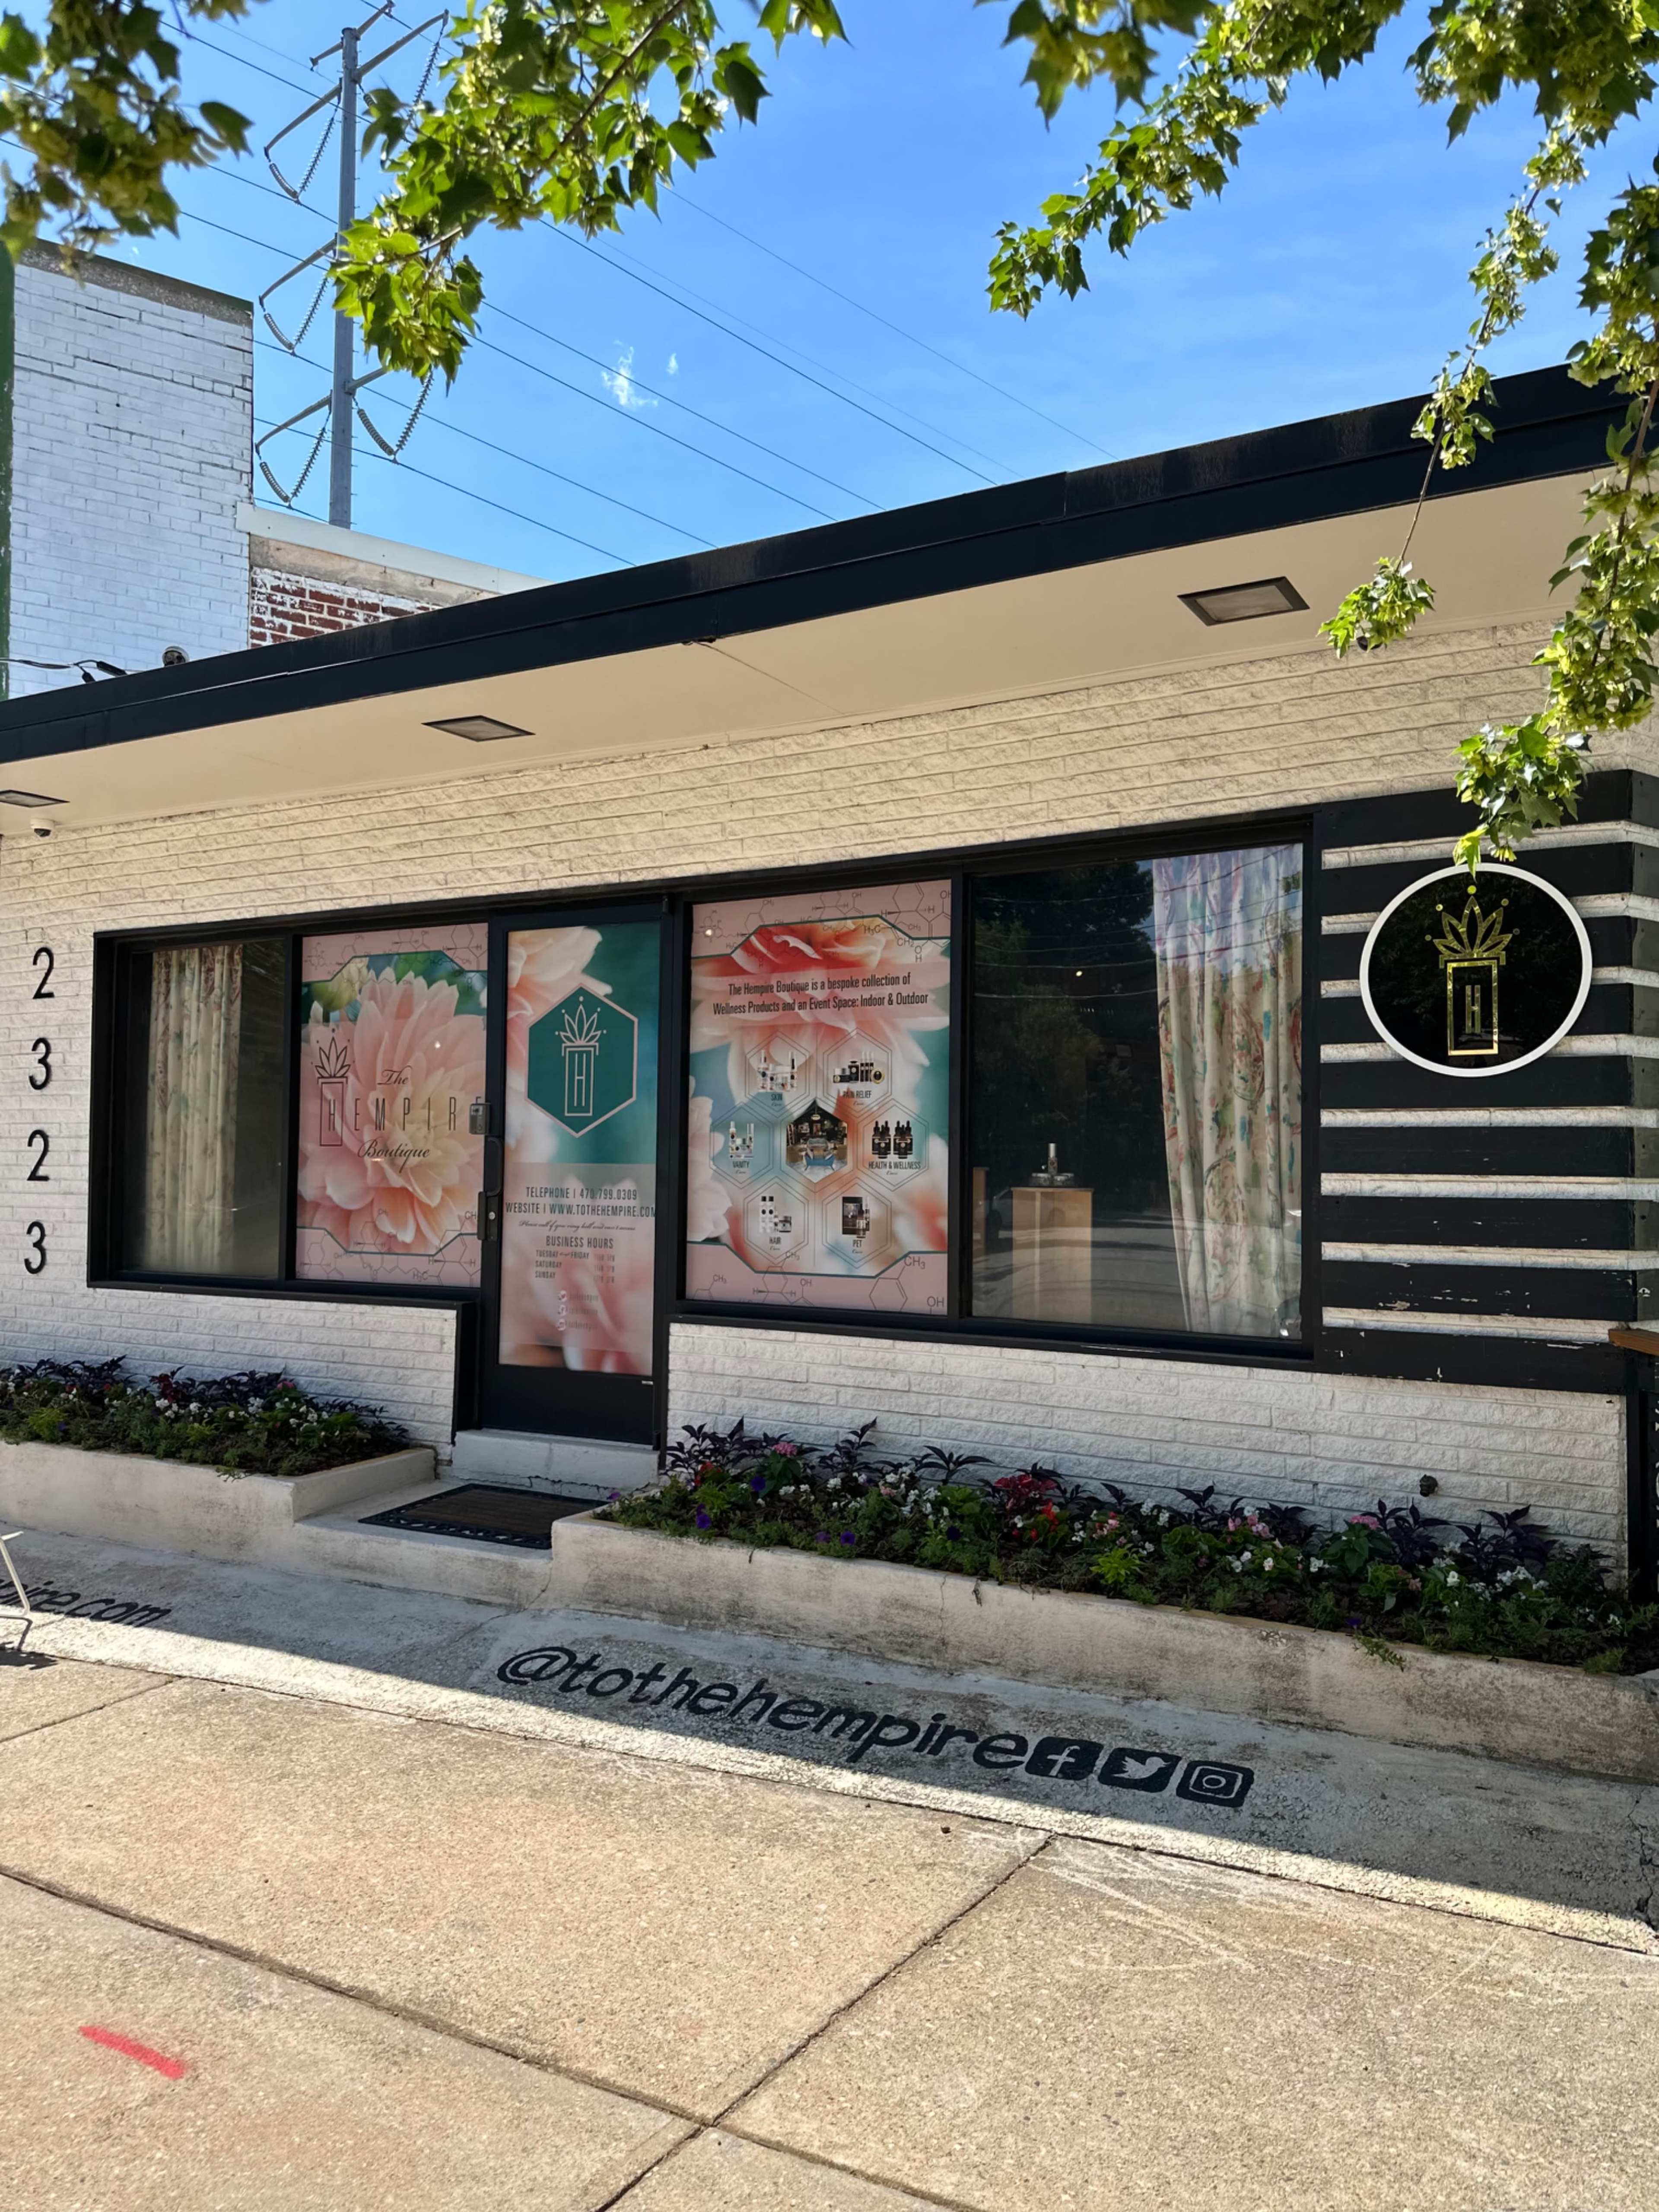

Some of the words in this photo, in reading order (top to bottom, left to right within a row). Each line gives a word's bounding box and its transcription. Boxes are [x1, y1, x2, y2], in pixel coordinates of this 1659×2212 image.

[728, 983, 742, 995] The
[744, 982, 774, 996] Hempire
[776, 979, 809, 994] Boutique
[811, 978, 818, 990] is
[820, 981, 825, 990] a
[827, 976, 859, 991] bespoke
[862, 973, 899, 987] collection
[903, 972, 911, 985] of
[713, 1002, 746, 1015] Wellness
[748, 1001, 779, 1013] Products
[782, 999, 796, 1011] and
[798, 1001, 807, 1010] an
[809, 997, 830, 1010] Event
[833, 996, 859, 1011] Space:
[861, 994, 885, 1007] Indoor
[888, 993, 893, 1005] &
[896, 992, 928, 1005] Outdoor
[377, 1065, 412, 1085] The
[771, 1093, 783, 1101] SKIN
[856, 1090, 871, 1098] RELIEF
[328, 1096, 482, 1131] HEMPIR
[357, 1137, 431, 1173] Boutique
[868, 1161, 887, 1169] HEALTH
[893, 1161, 921, 1170] WELLNESS
[526, 1187, 570, 1199] TELEPHONE
[579, 1189, 637, 1201] 470.799.0309
[505, 1202, 540, 1214] WEBSITE
[546, 1235, 583, 1248] BUSINESS
[587, 1237, 613, 1249] HOURS
[852, 1239, 862, 1248] PET
[536, 1249, 559, 1258] TUESDAY
[535, 1260, 562, 1269] SATURDAY
[904, 1256, 926, 1270] CH3
[535, 1271, 556, 1279] SUNDAY
[927, 1296, 944, 1307] OH
[497, 1646, 1029, 1769] @tothehempire
